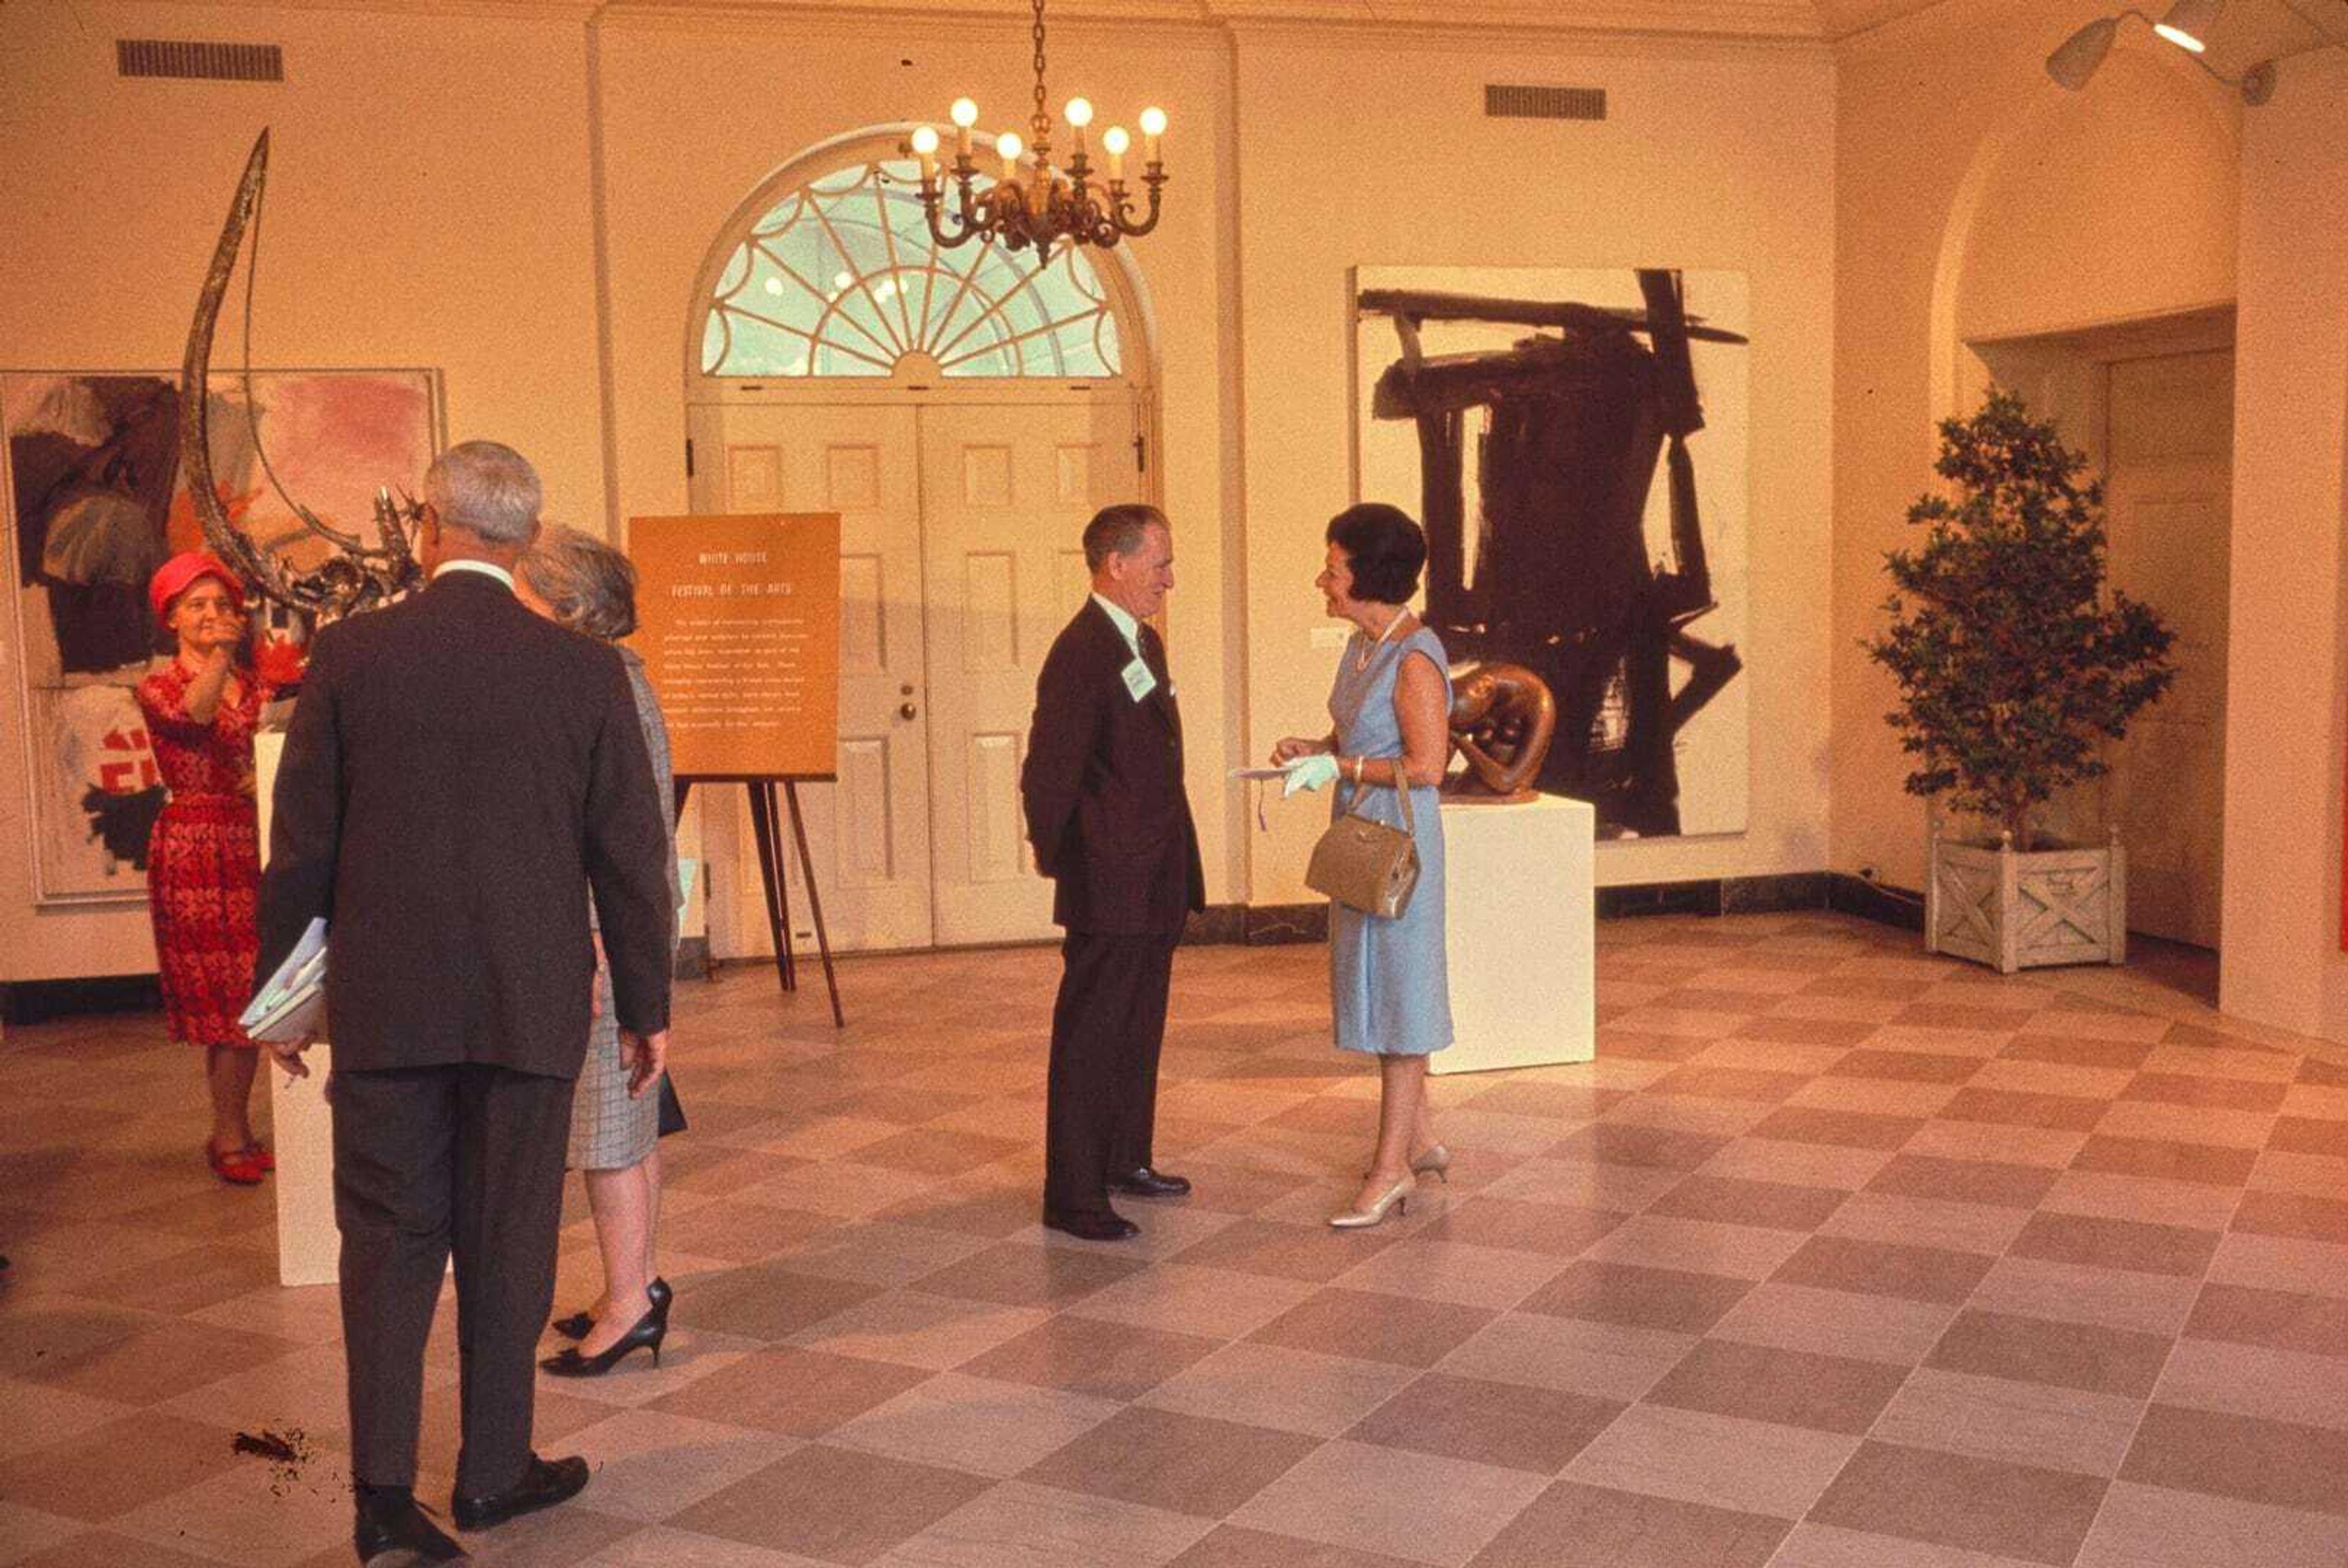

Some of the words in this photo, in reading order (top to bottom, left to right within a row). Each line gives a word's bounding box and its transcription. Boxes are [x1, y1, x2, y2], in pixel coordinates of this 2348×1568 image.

[699, 552, 728, 564] WHITE
[734, 551, 767, 564] HOUSE
[671, 584, 713, 597] FESTIVAL
[720, 583, 731, 595] OF
[741, 583, 758, 595] THE
[767, 582, 791, 595] ARTS
